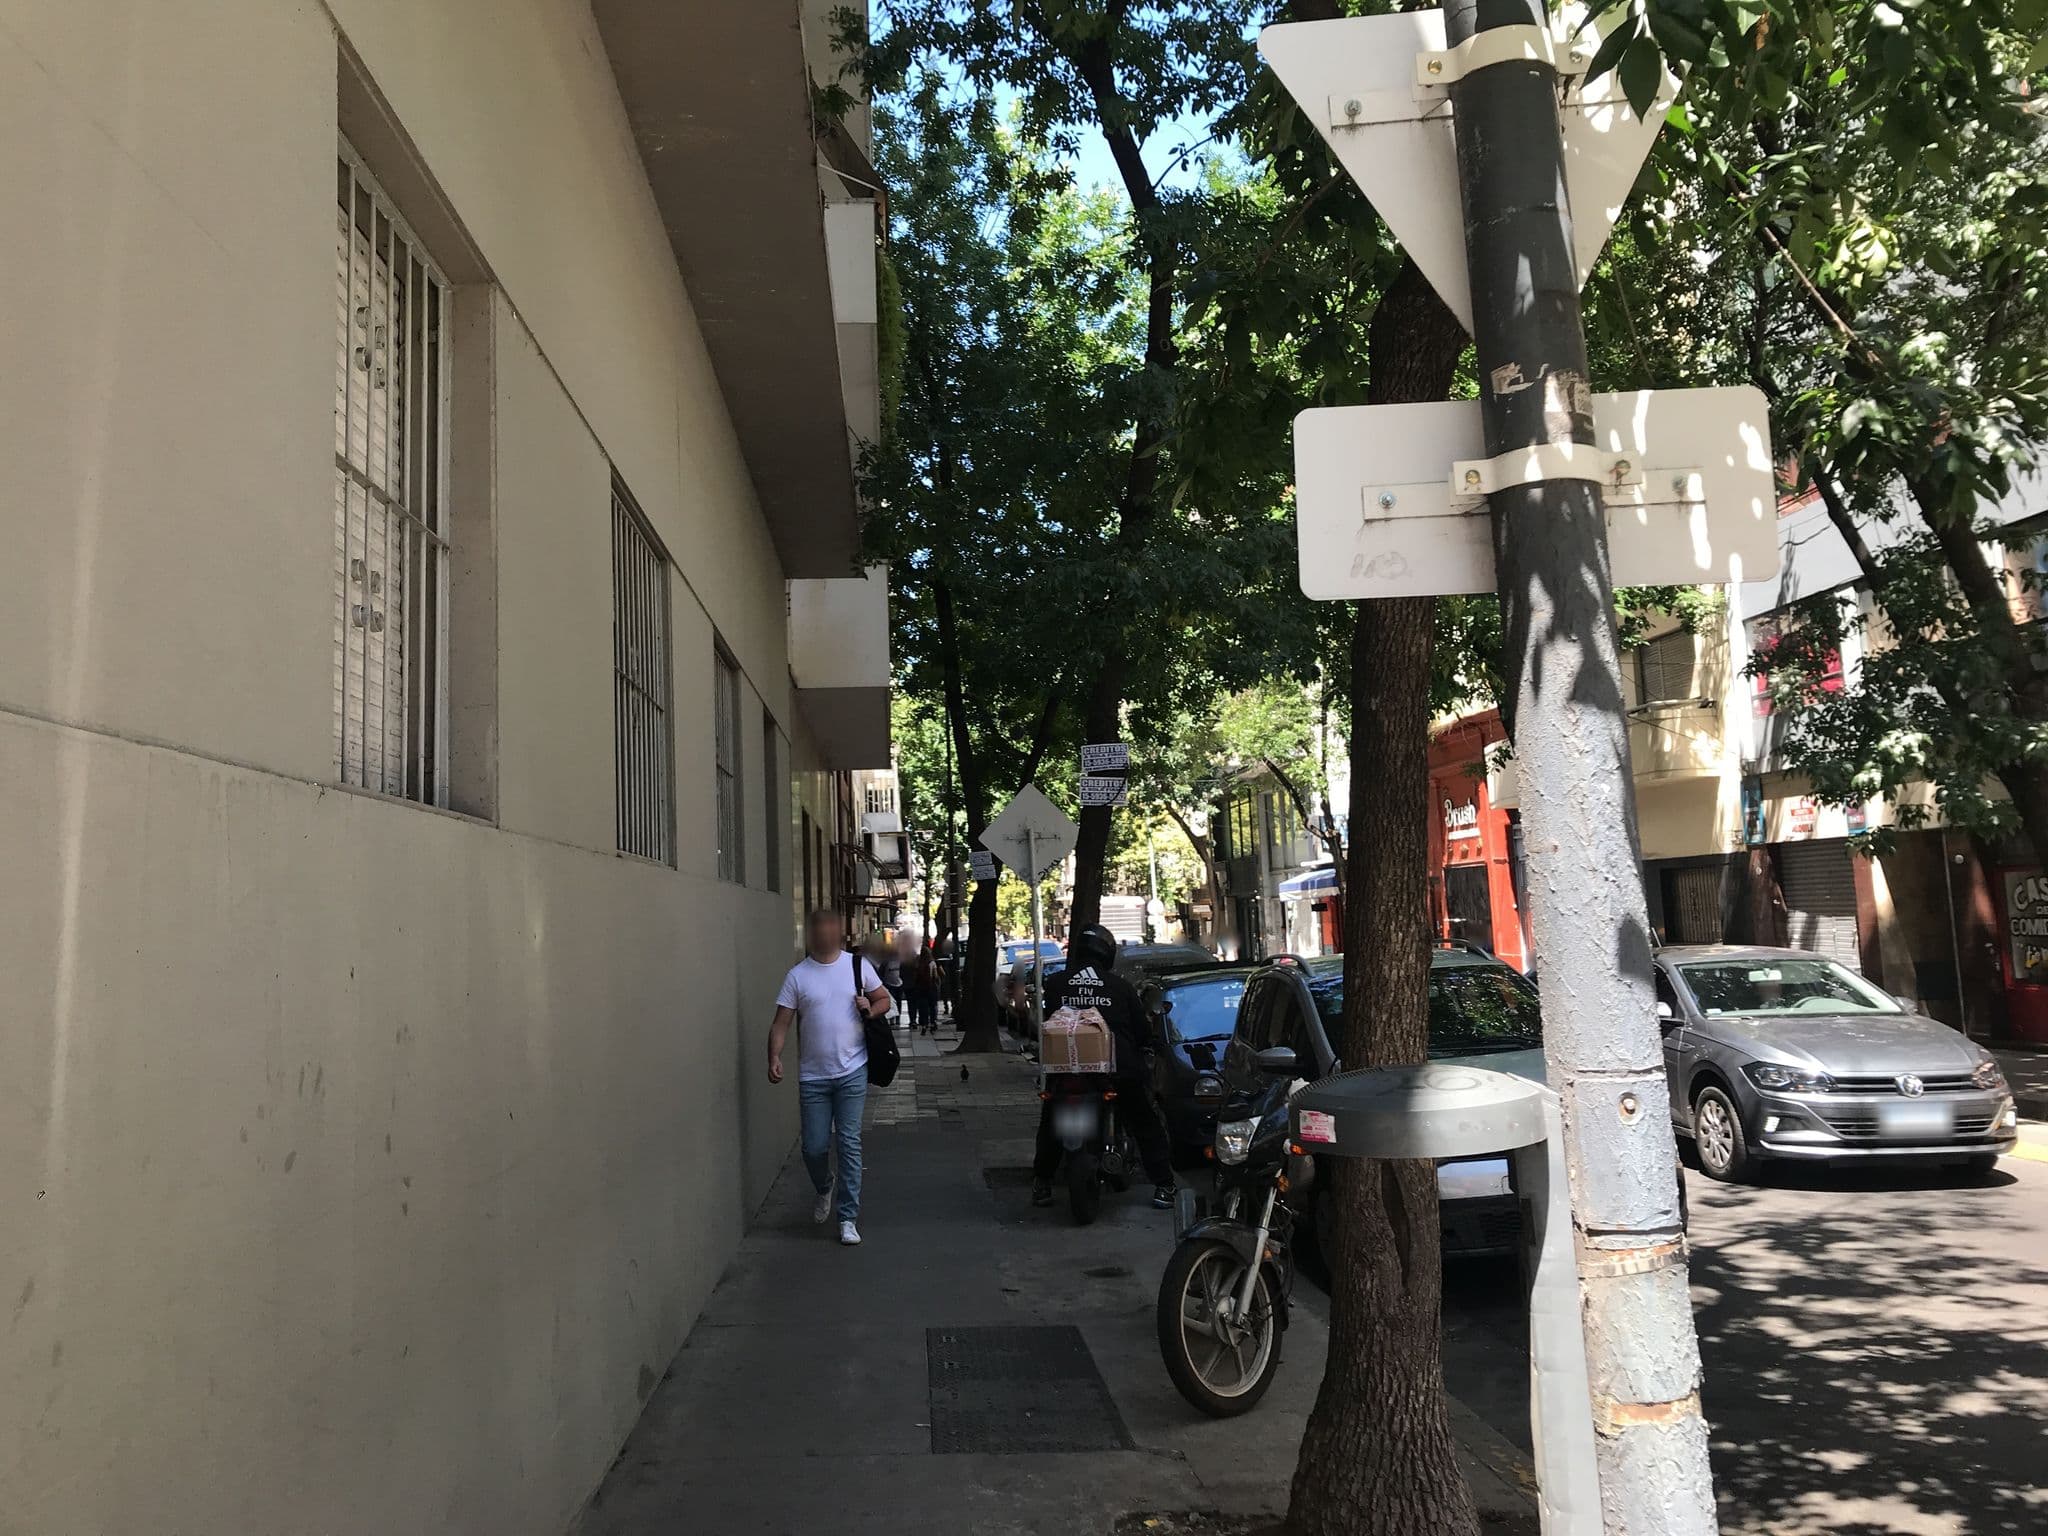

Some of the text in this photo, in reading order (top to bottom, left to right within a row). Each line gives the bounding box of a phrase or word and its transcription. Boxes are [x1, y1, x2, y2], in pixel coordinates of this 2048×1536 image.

[1084, 745, 1126, 754] CREDITOS
[1444, 797, 1476, 827] Brush
[1068, 977, 1104, 987] adidas
[1078, 987, 1094, 997] Fly
[1061, 995, 1112, 1007] Emirates
